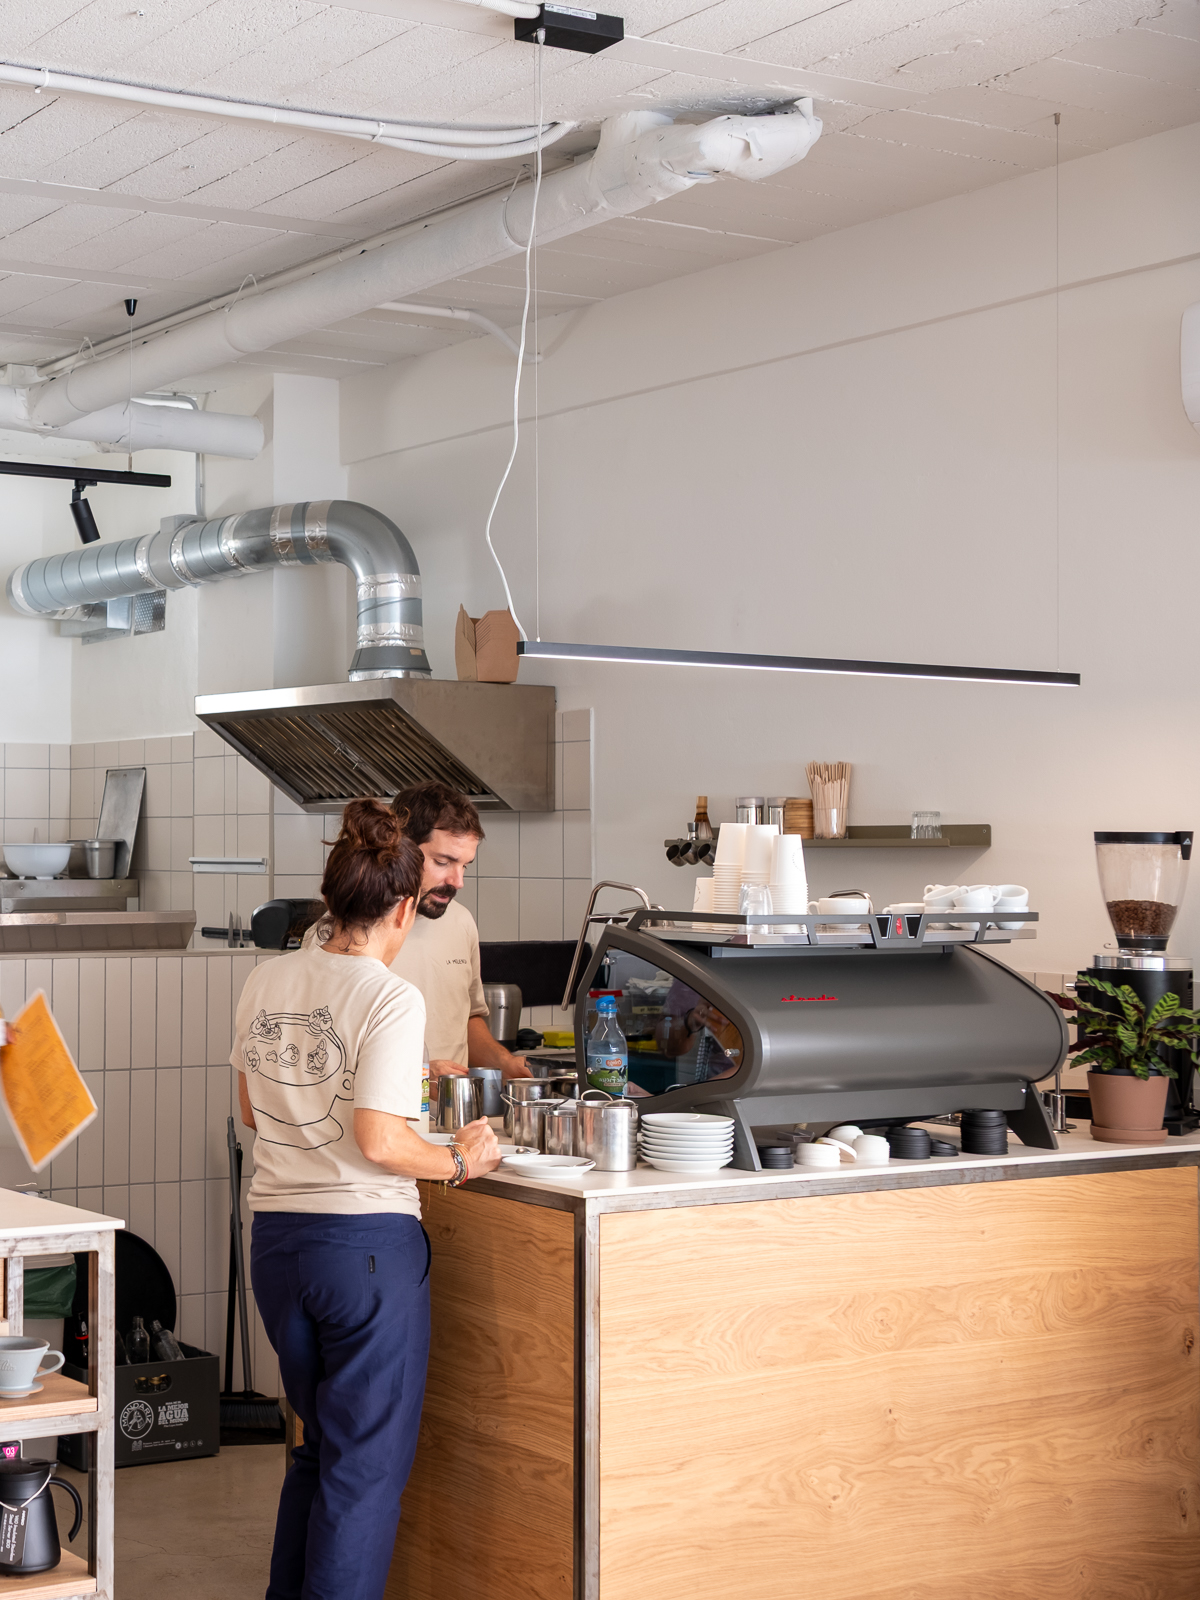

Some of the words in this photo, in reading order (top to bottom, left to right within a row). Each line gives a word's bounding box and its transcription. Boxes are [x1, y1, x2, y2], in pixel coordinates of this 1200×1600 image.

[168, 1402, 189, 1410] MEJOR
[122, 1402, 152, 1427] MONDARIZ
[158, 1408, 189, 1421] AGUA
[5, 1446, 15, 1456] 03
